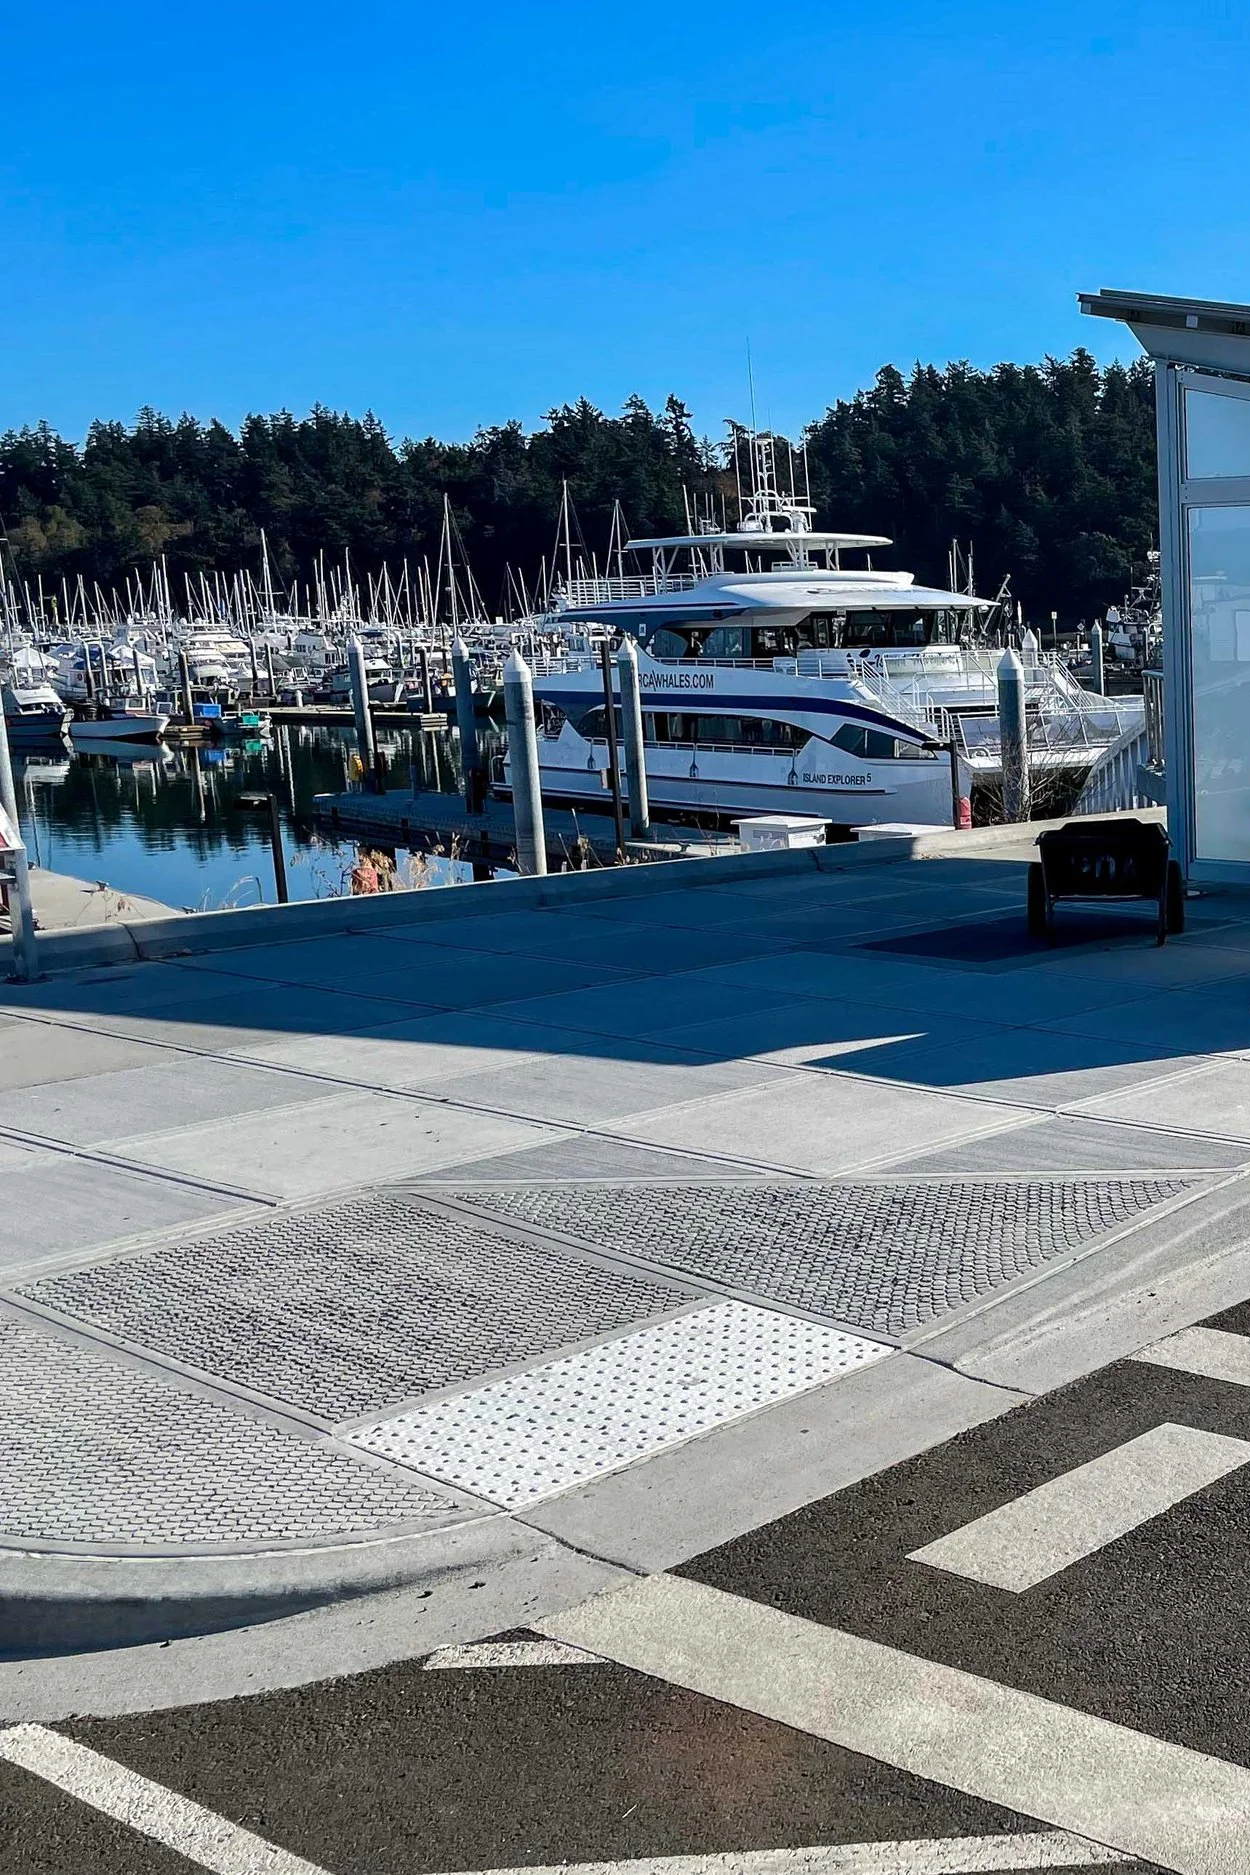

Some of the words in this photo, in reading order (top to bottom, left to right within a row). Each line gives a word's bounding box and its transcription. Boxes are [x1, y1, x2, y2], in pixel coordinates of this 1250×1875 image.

[639, 672, 714, 690] RCAWHALES.COM
[803, 773, 826, 783] ISLAND
[828, 775, 866, 785] EXPLORER
